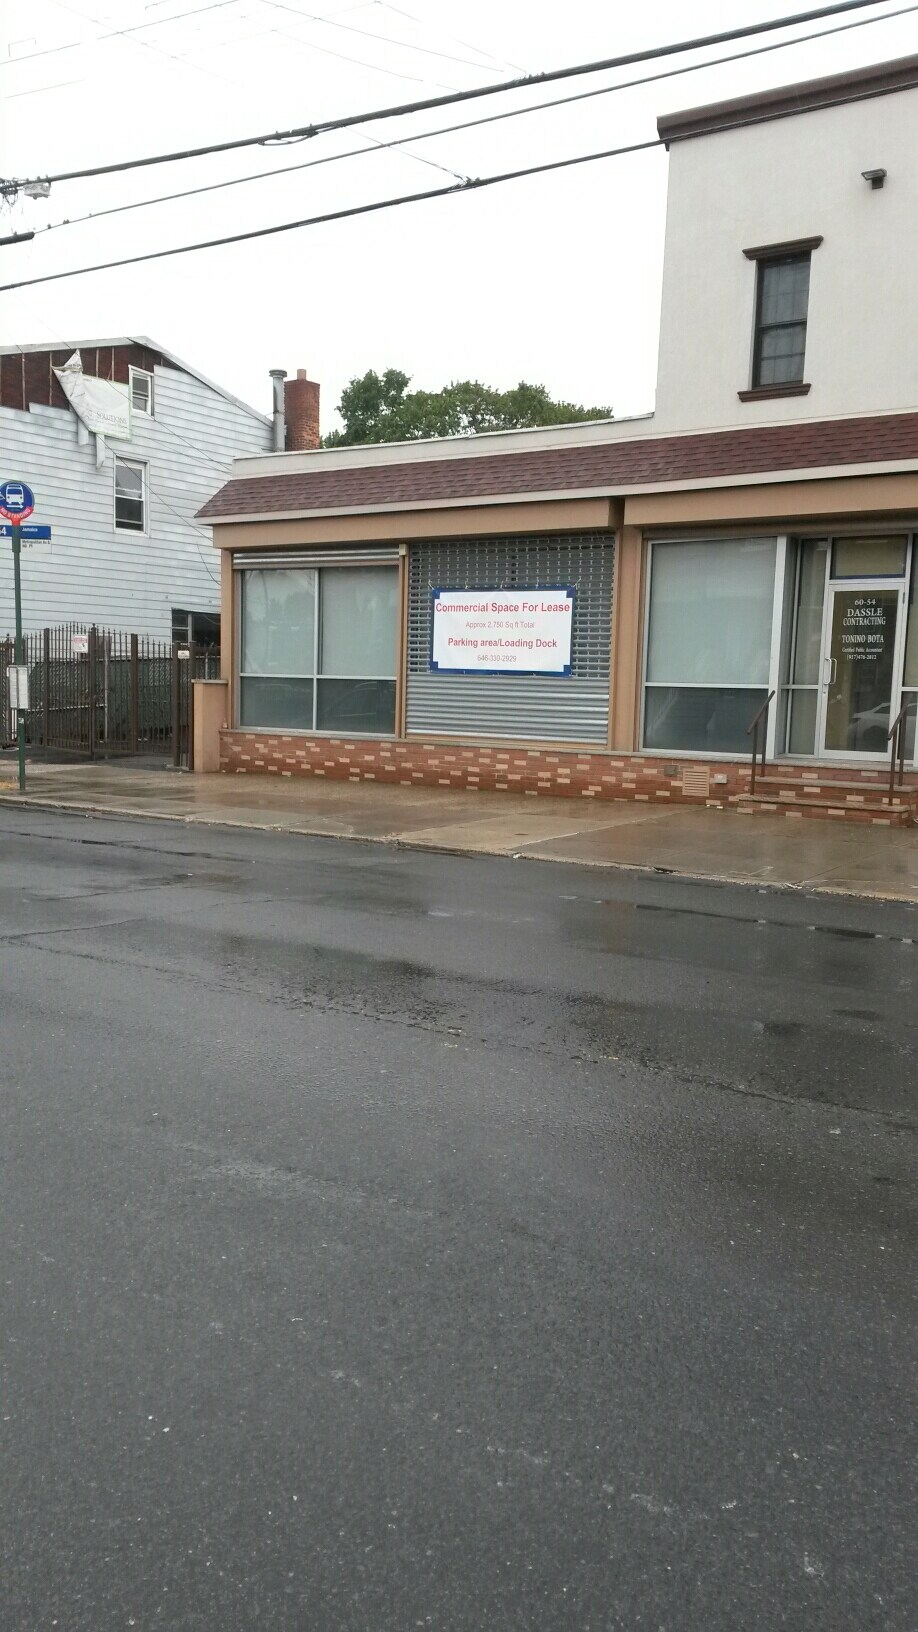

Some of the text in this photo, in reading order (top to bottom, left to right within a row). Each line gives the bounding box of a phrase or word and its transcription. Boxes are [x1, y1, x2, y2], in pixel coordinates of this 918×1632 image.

[436, 602, 570, 614] Commercial Space For Lease
[847, 608, 883, 616] DASSLE
[466, 621, 486, 629] Approx
[505, 621, 514, 629] Sq
[843, 616, 886, 626] CONTRACTING
[842, 634, 884, 643] TONINO BOTA
[448, 638, 558, 649] Parking area/Loading Dock
[477, 654, 517, 662] 646-330-2929
